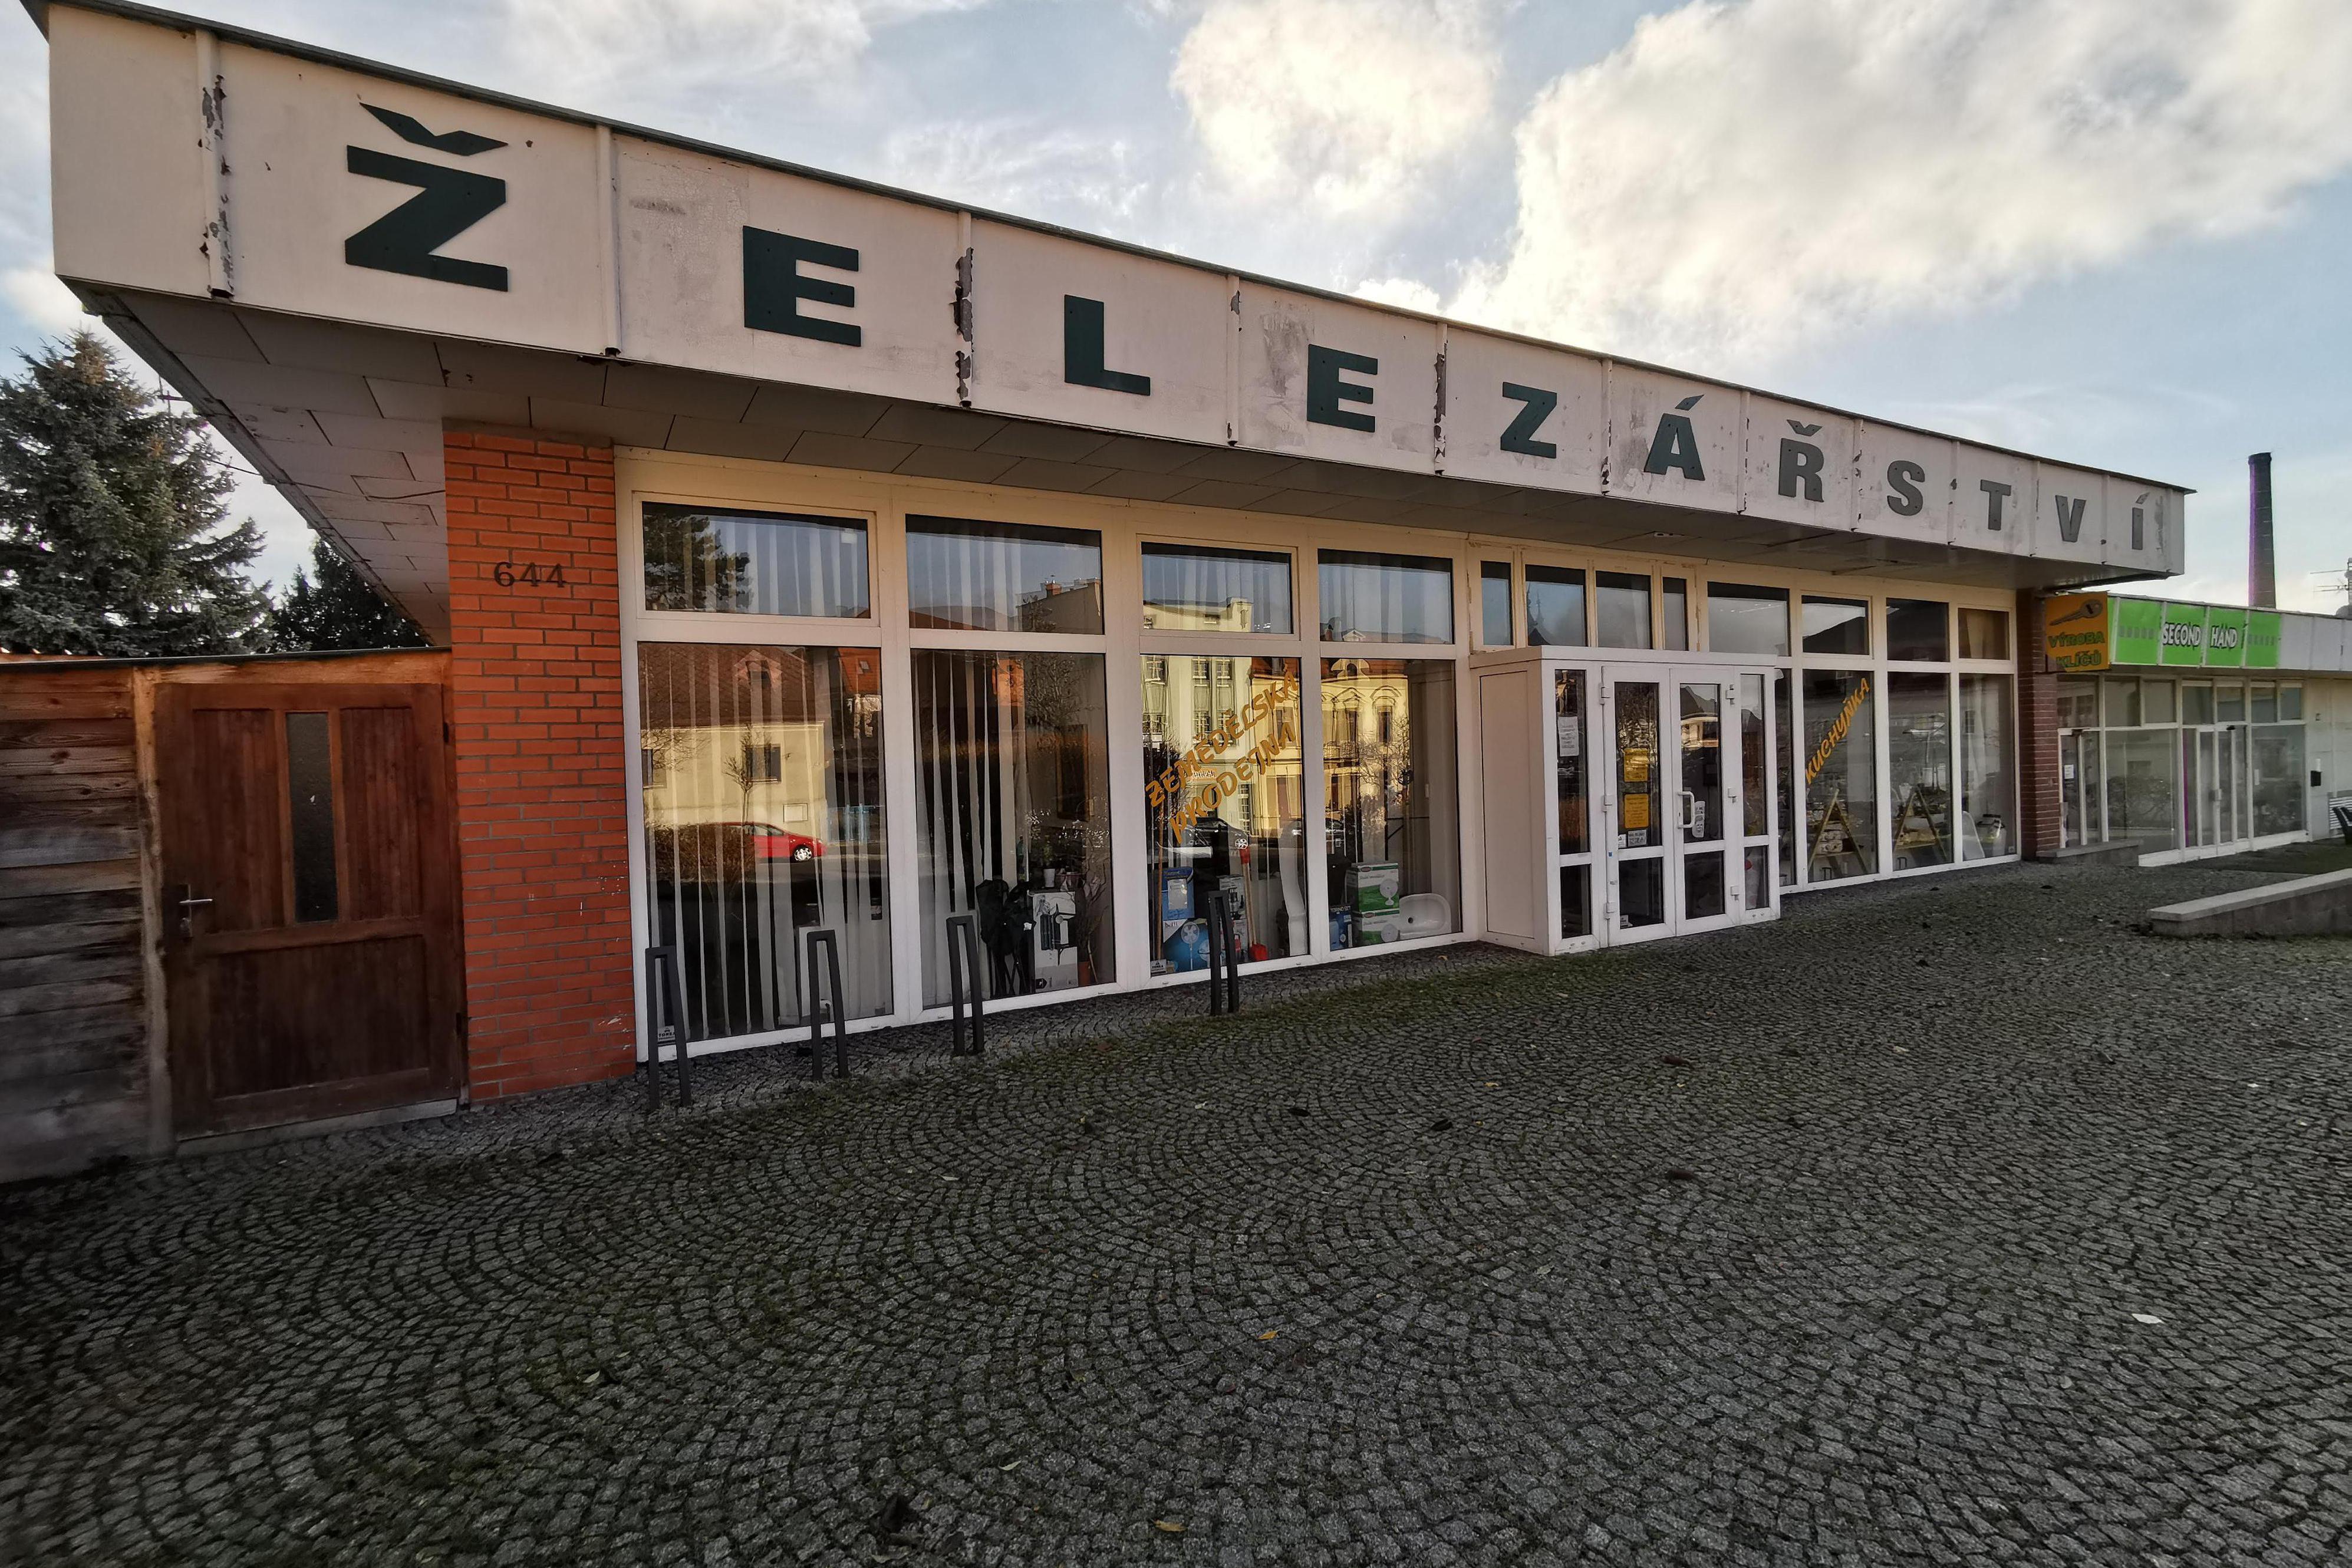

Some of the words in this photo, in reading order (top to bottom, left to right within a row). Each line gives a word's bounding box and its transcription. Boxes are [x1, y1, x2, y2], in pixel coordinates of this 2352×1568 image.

[345, 103, 2150, 550] ŽELEZÁŘSTVÍ
[494, 561, 567, 588] 644
[2048, 631, 2105, 648] VÝROBA
[2055, 650, 2102, 668] KLÍČŮ
[2163, 622, 2201, 650] SECOND
[2210, 624, 2238, 649] HAND
[1145, 664, 1299, 808] ZEMĚDĚLSKÁ
[1805, 678, 1870, 785] KUCHYŇKA
[1170, 722, 1296, 844] PRODEJNA
